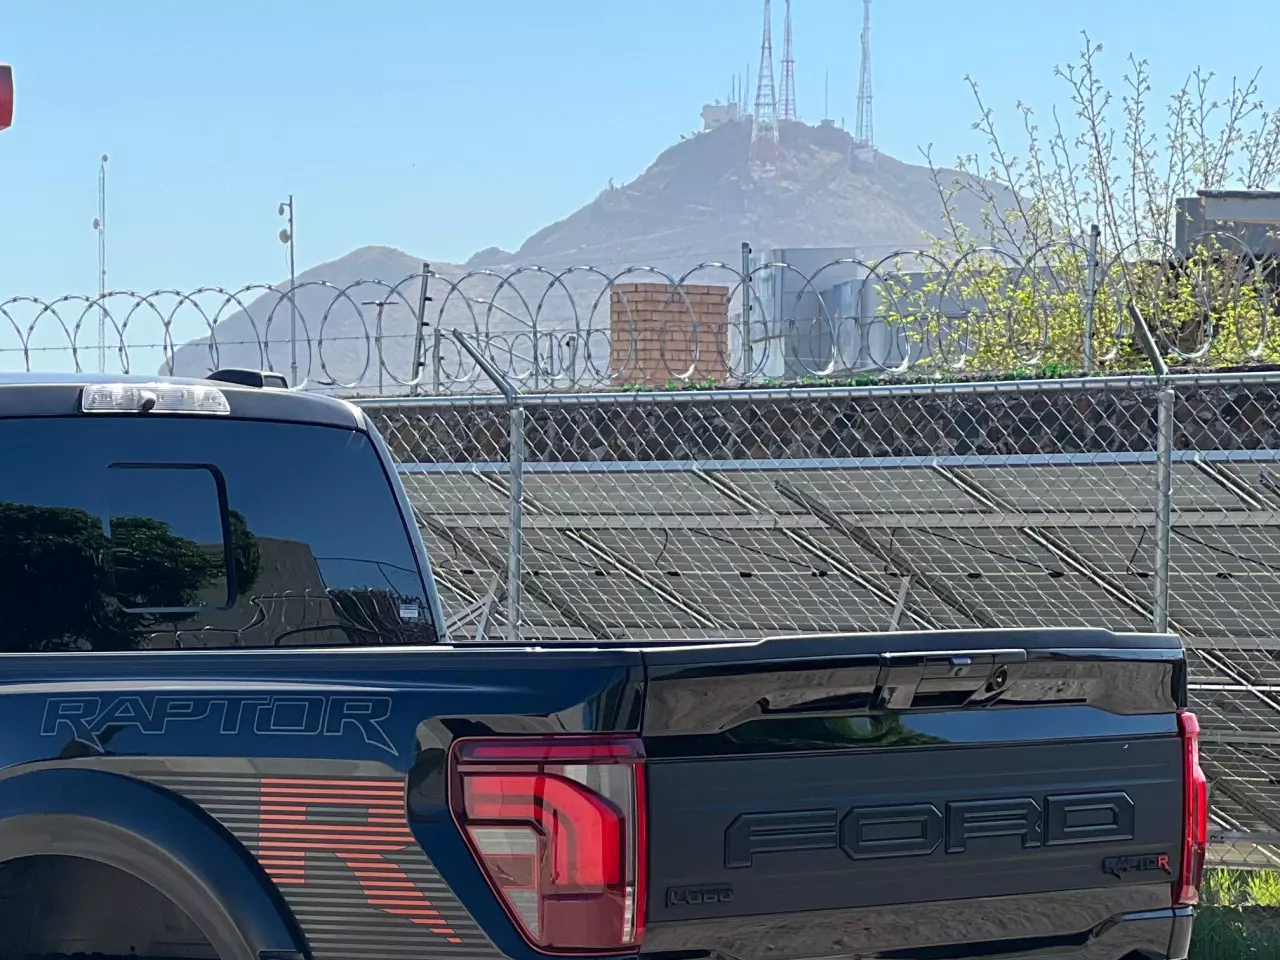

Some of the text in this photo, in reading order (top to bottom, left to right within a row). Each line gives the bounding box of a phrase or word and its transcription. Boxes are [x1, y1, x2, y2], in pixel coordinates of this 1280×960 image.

[40, 696, 399, 756] RAPTOR
[724, 791, 1135, 868] FORD
[1101, 852, 1173, 880] RAPTOR
